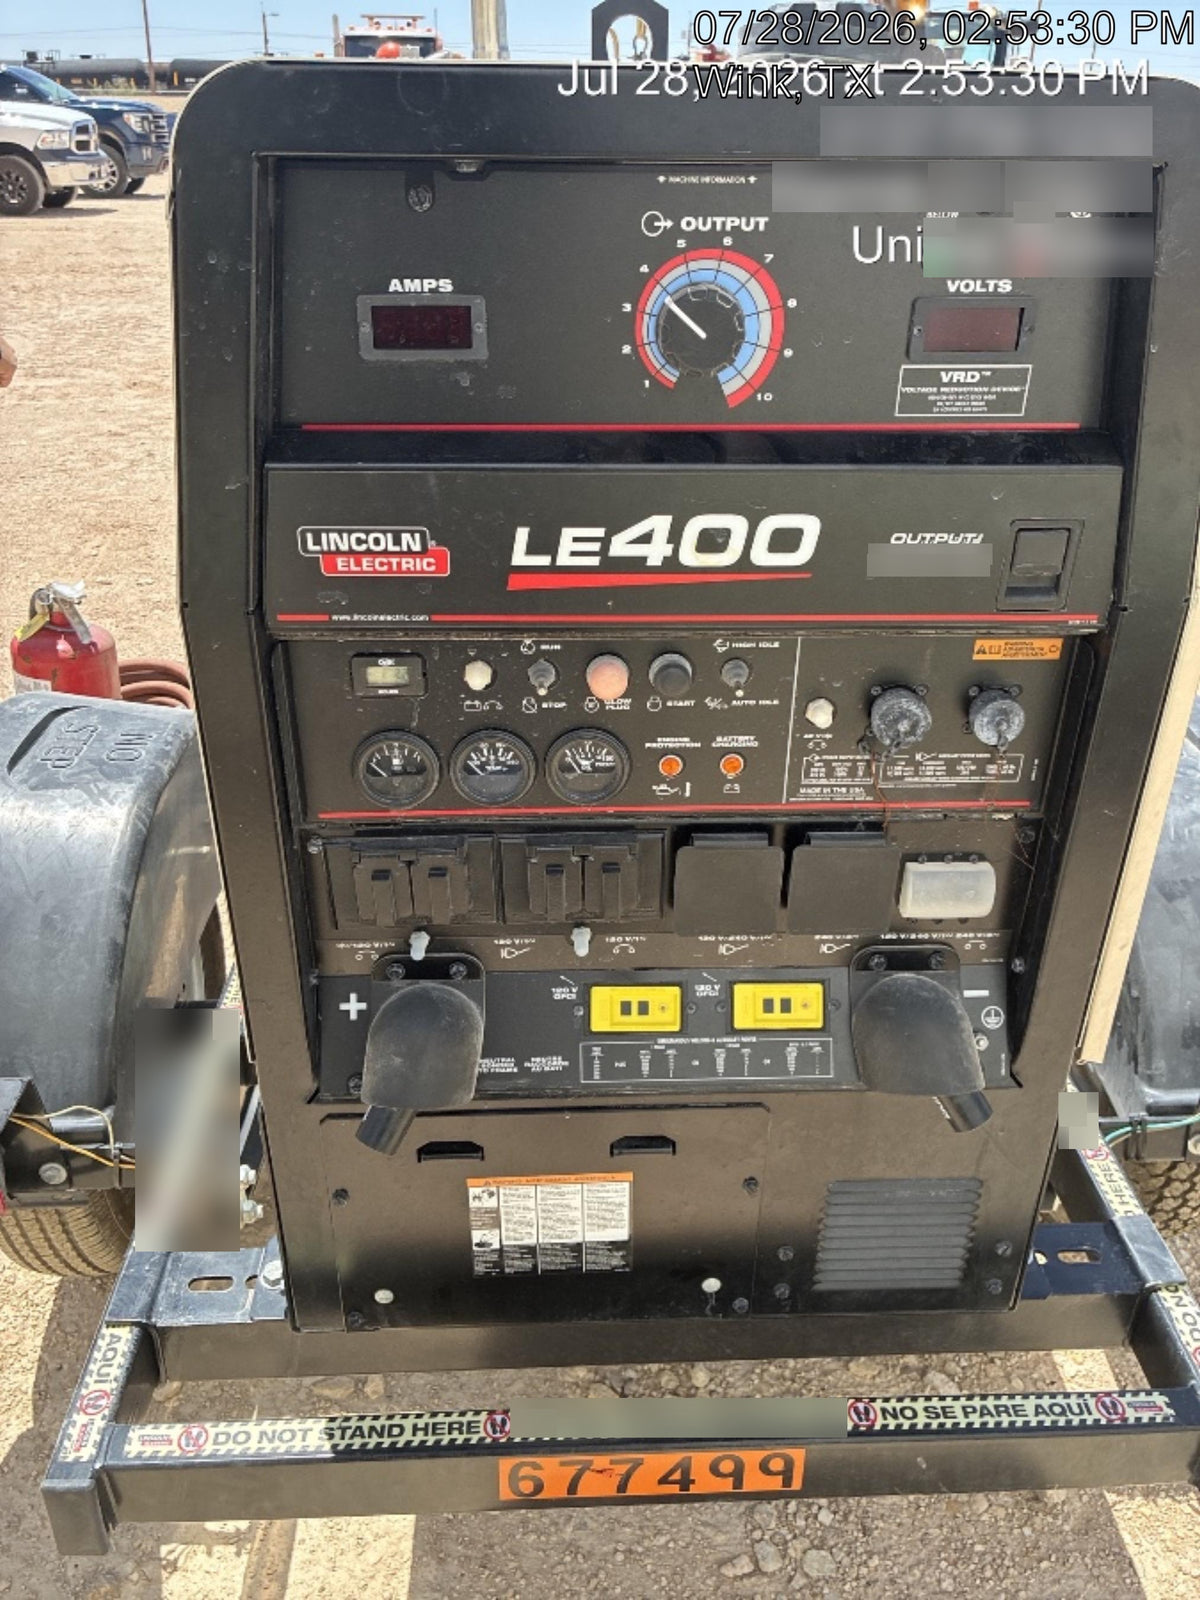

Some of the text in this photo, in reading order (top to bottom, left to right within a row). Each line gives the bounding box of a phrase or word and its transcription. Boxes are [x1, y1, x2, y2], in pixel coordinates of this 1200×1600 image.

[680, 216, 769, 232] OUTPUT
[676, 239, 687, 248] 5
[723, 236, 733, 246] 6
[763, 253, 774, 263] 7
[639, 264, 650, 273] 4
[388, 278, 454, 293] AMPS
[946, 279, 1013, 293] VOLTS
[621, 303, 632, 312] 3
[644, 379, 650, 388] 1
[756, 392, 773, 401] 10
[305, 532, 422, 552] LINCOLN
[511, 514, 822, 566] LE400
[336, 557, 437, 572] ELECTRIC
[880, 1406, 916, 1421] NO
[924, 1404, 958, 1419] SE
[963, 1401, 1028, 1419] PARE
[212, 1419, 481, 1446] DO NOT STAND HERE
[508, 1452, 795, 1498] 677499
